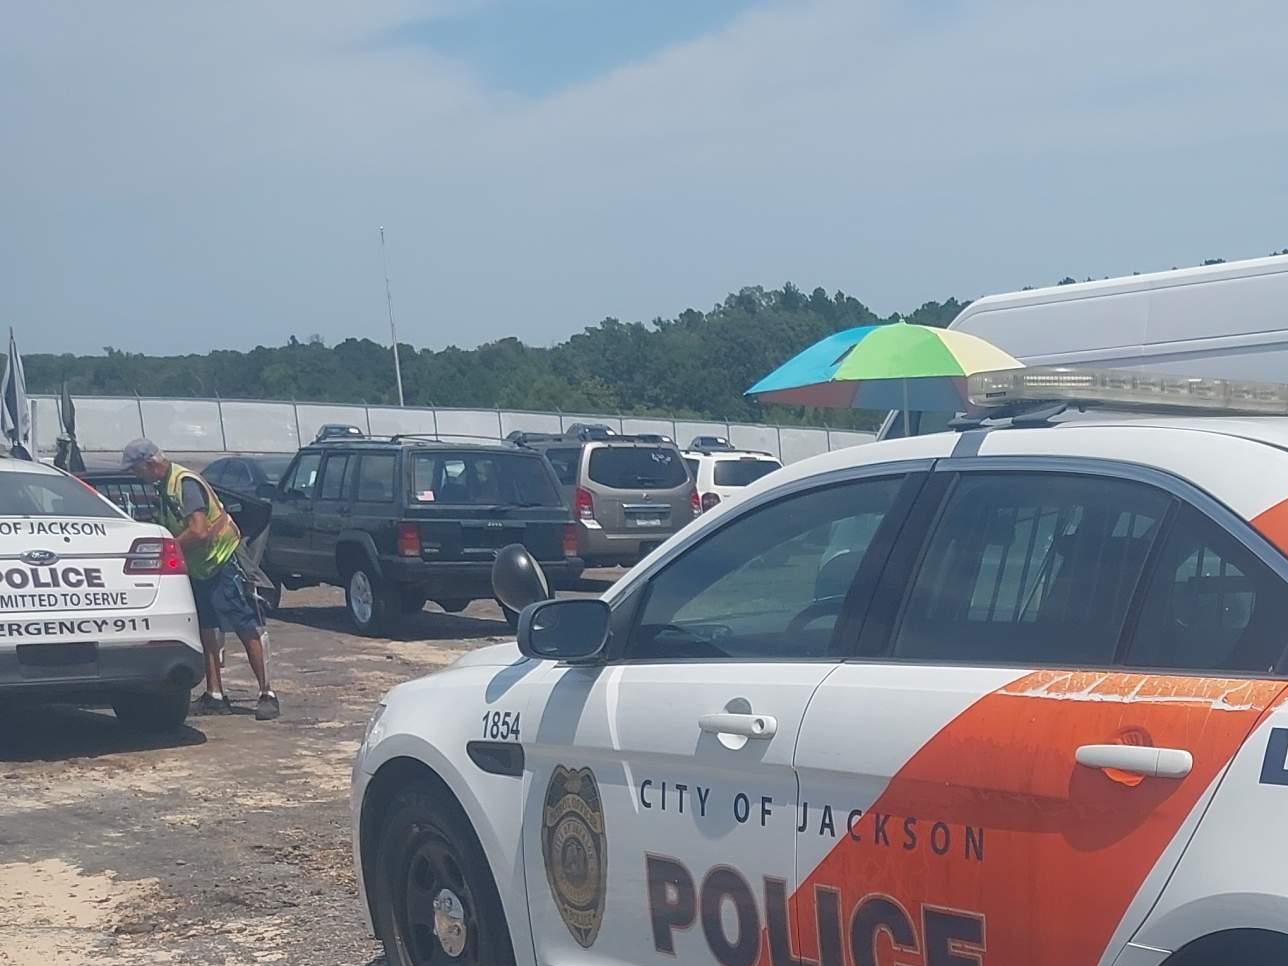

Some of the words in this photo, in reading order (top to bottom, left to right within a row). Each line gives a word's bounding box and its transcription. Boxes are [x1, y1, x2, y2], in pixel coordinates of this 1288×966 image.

[28, 522, 107, 536] JACKSON
[0, 567, 105, 589] OLICE
[61, 593, 80, 607] TO
[85, 592, 128, 606] SERVE
[113, 618, 150, 632] 911
[482, 711, 520, 740] 1854
[640, 779, 710, 816] CITY
[733, 793, 772, 826] OF
[798, 801, 984, 861] JACKSON
